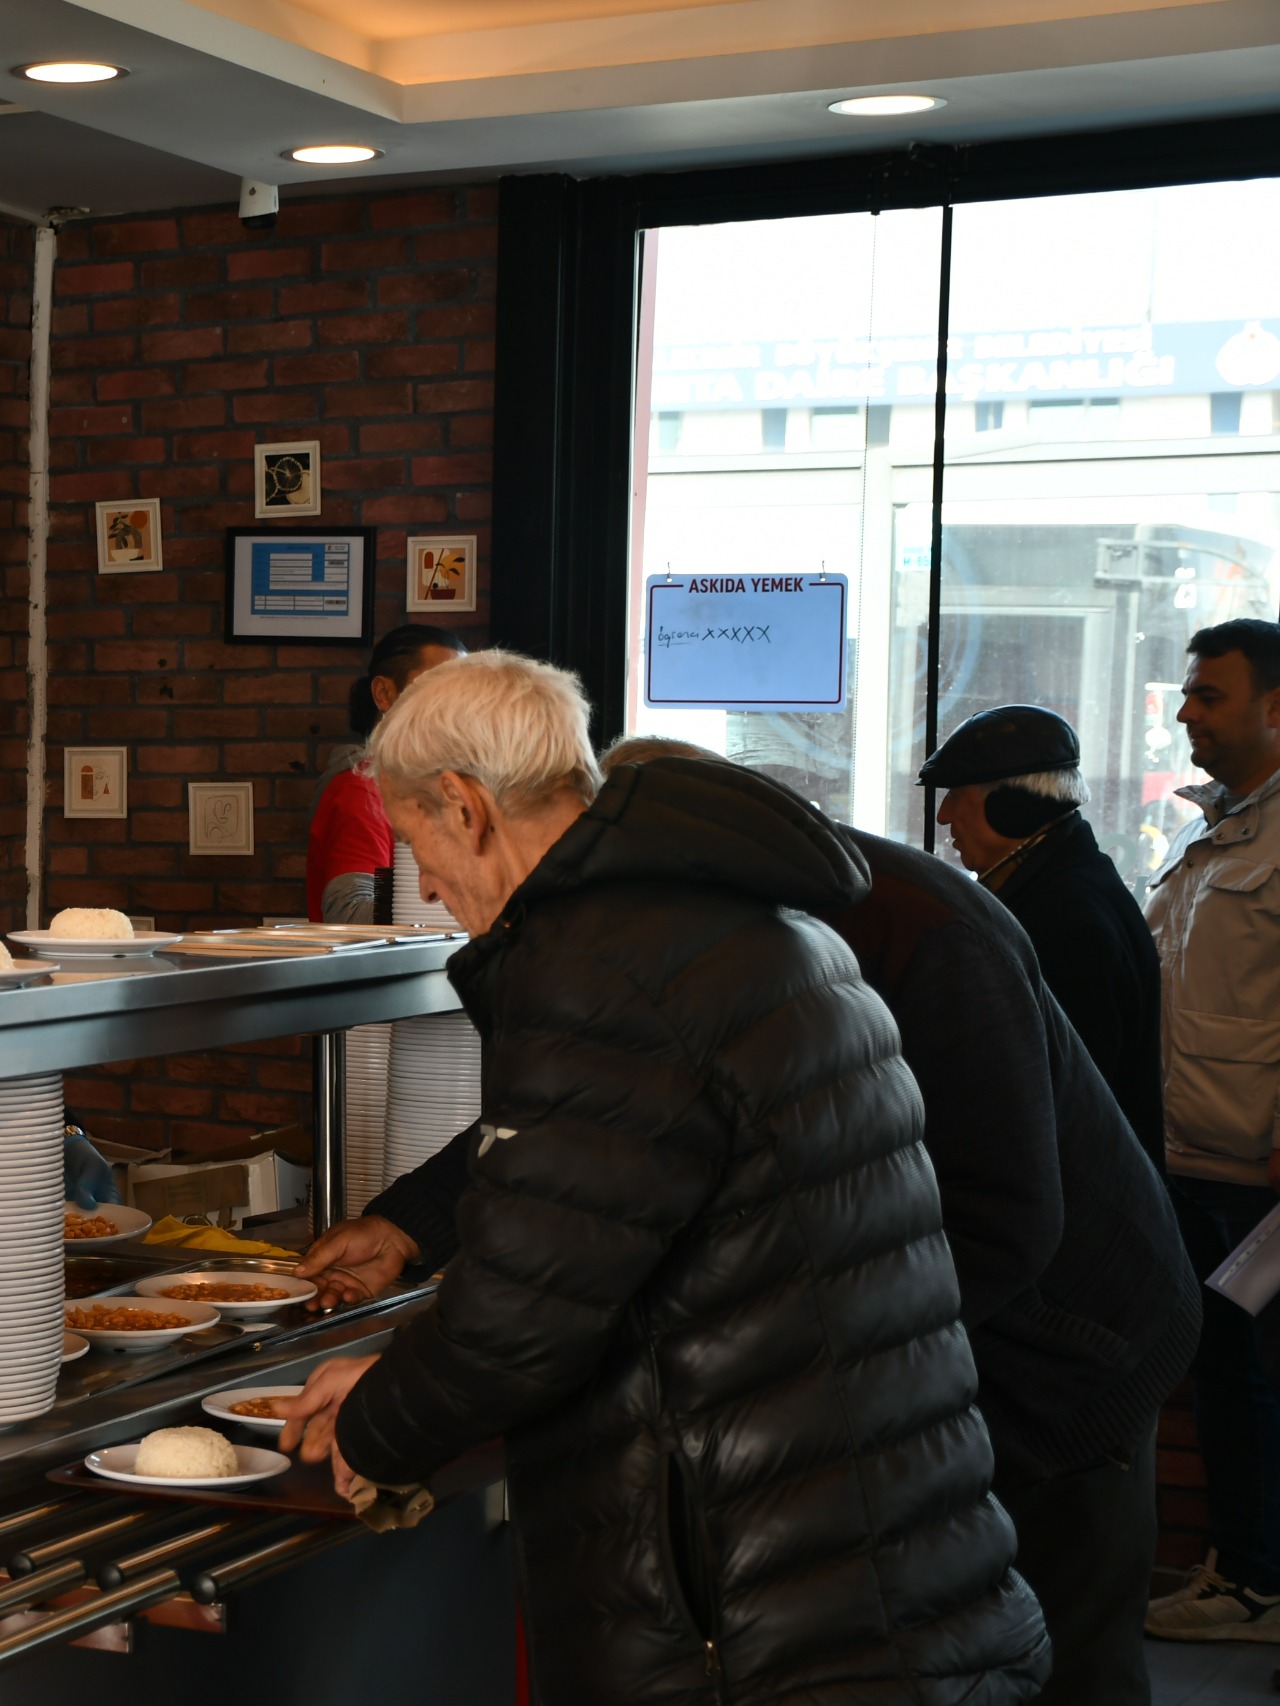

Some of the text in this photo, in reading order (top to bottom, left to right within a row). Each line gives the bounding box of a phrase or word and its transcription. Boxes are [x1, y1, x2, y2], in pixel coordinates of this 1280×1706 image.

[896, 350, 1176, 401] BAŞKANLIĞI
[688, 577, 804, 594] ASKIDA YEMEK
